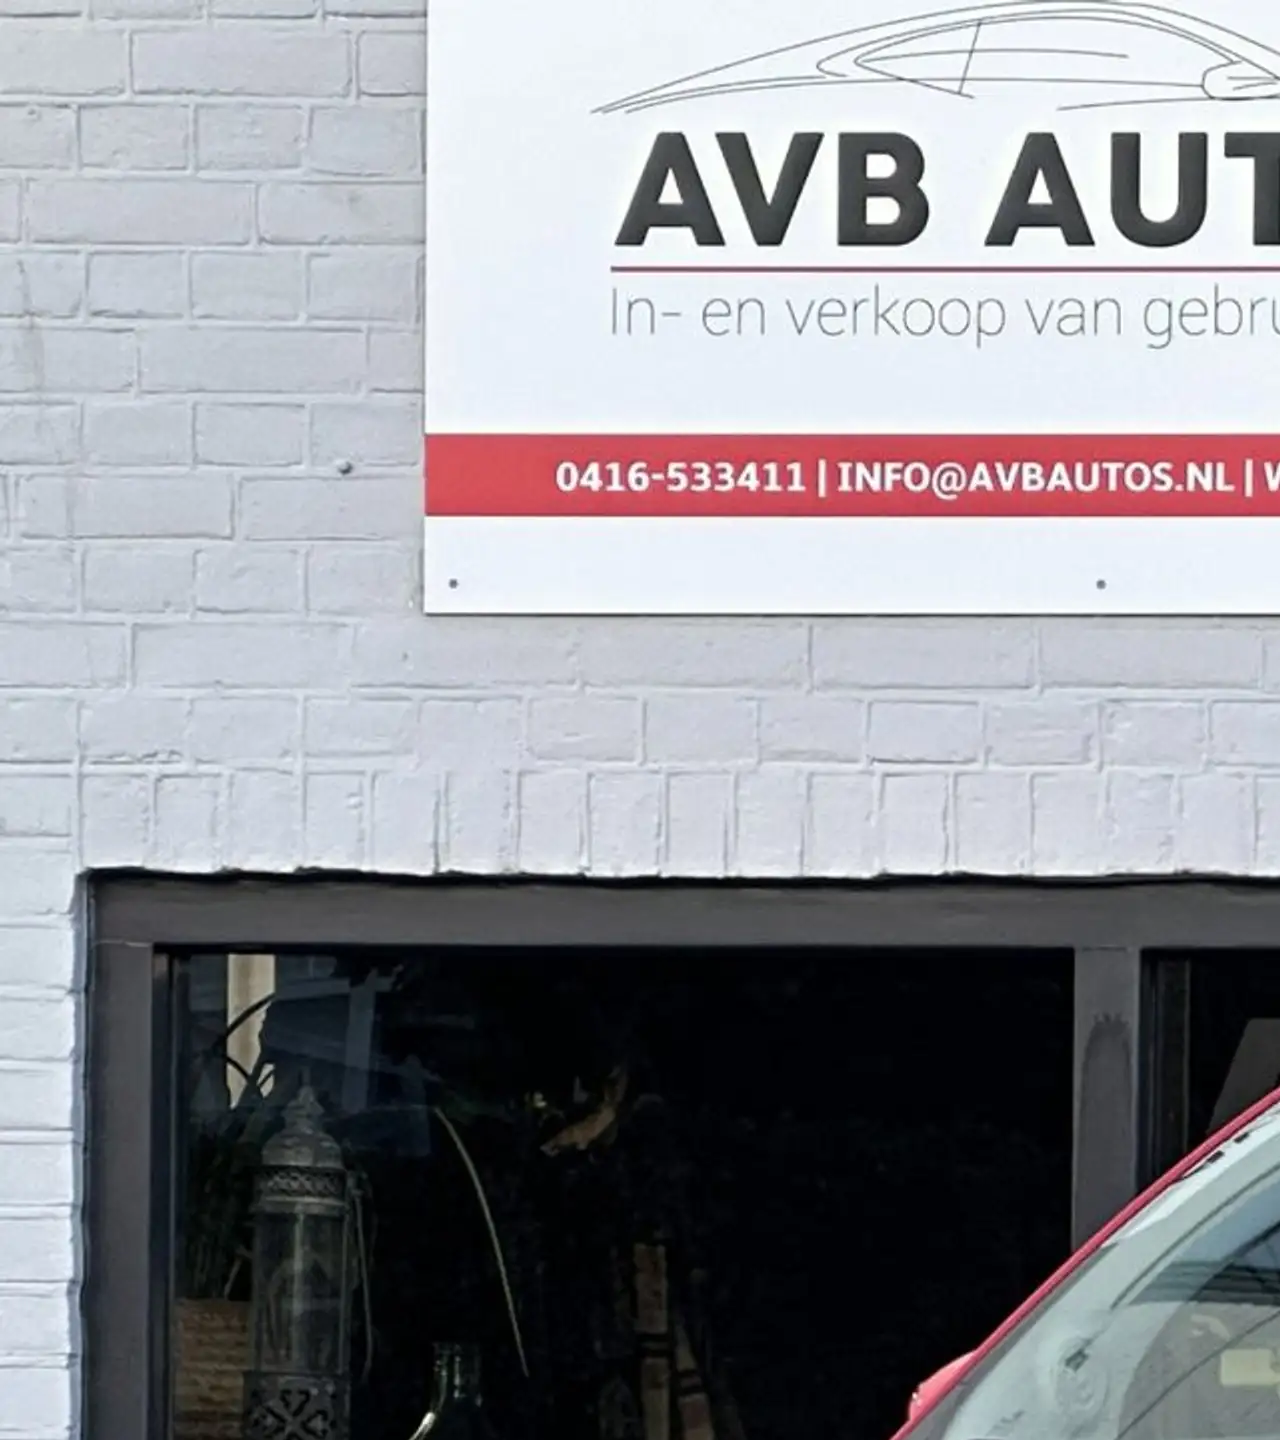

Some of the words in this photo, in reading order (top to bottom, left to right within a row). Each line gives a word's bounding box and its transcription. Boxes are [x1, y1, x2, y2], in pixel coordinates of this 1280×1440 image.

[614, 131, 930, 247] AVB
[610, 286, 682, 336] In-
[701, 296, 766, 337] en
[785, 283, 1007, 349] verkoop
[1025, 296, 1122, 337] van
[556, 460, 806, 493] 0416-533411
[837, 460, 1235, 500] INFO@AVBAUTOS.NL
